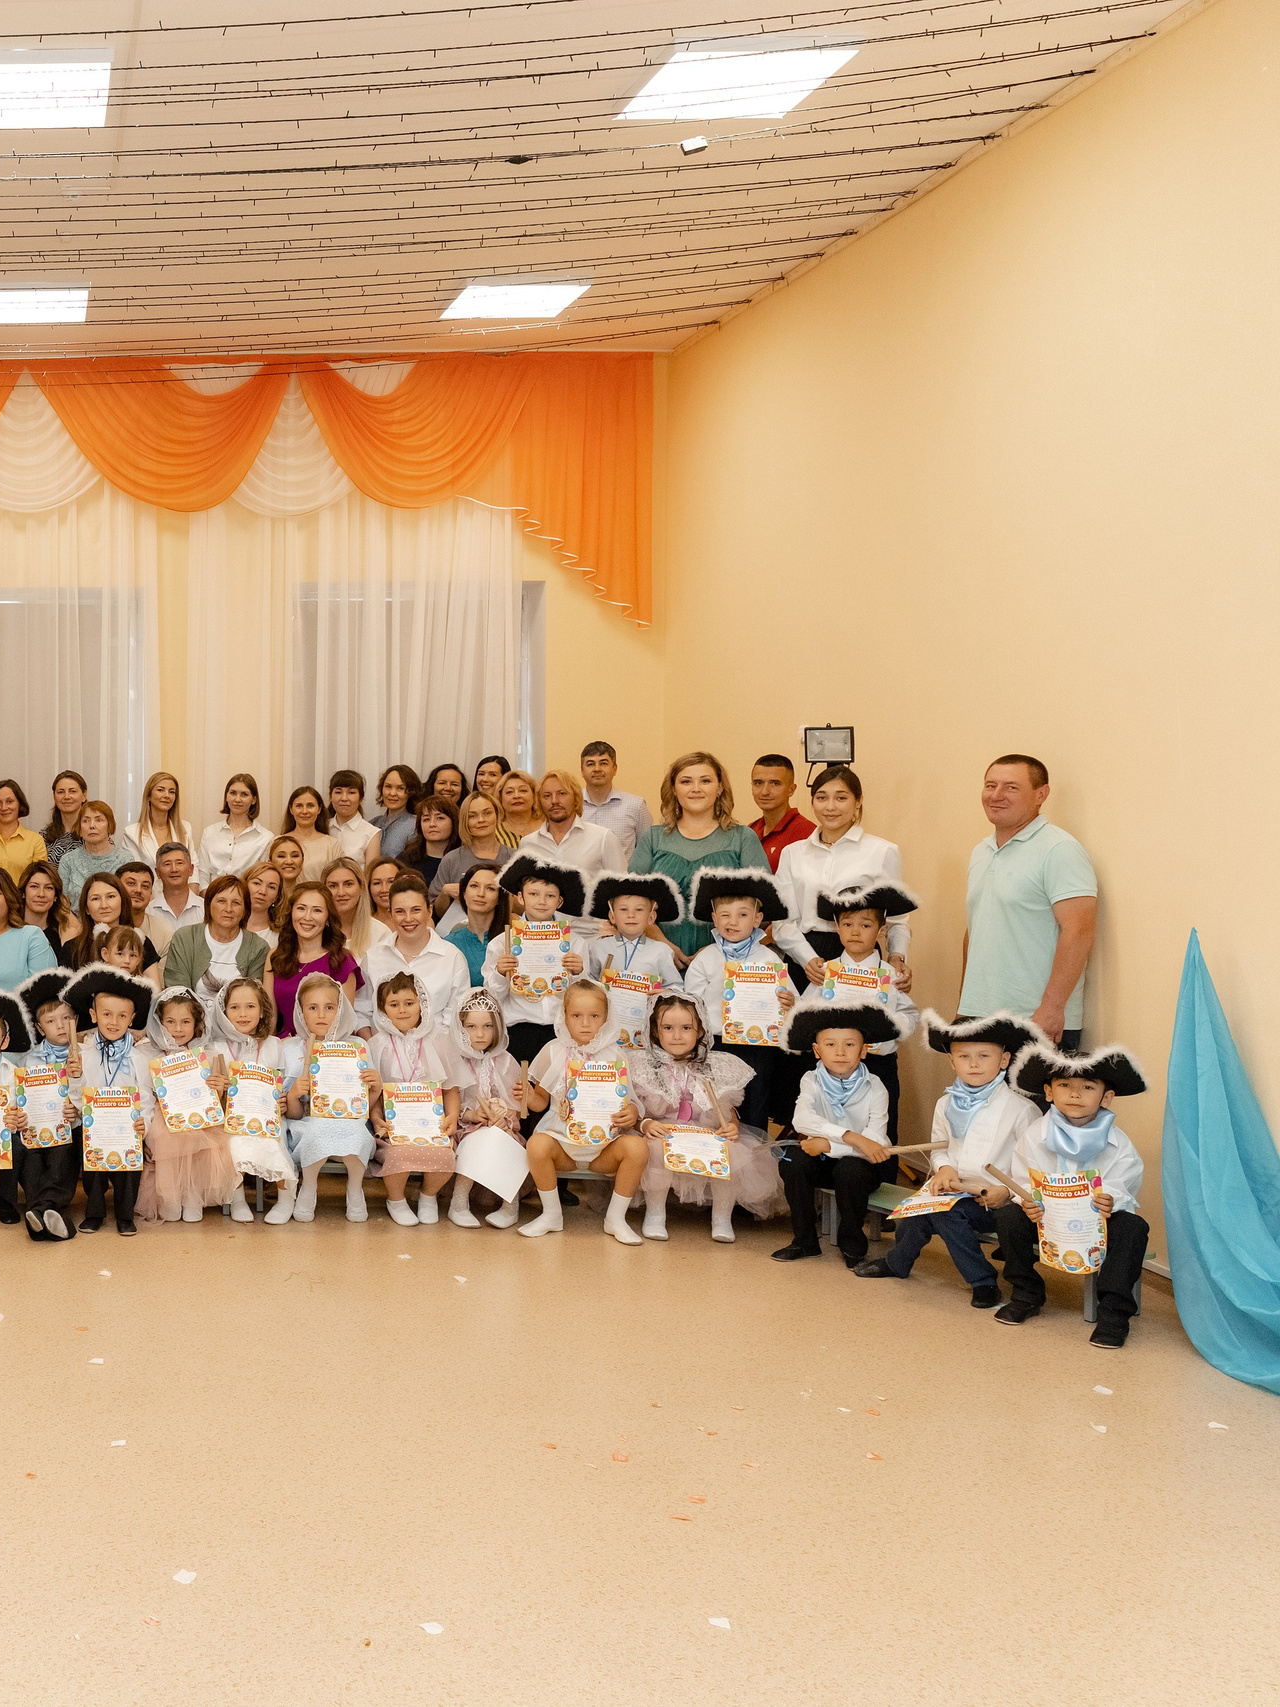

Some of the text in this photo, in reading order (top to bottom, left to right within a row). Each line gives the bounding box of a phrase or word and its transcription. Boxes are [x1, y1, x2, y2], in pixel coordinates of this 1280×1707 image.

[615, 972, 648, 982] ДИПЛОМ
[840, 967, 876, 977] ДИПЛОМ
[161, 1054, 193, 1067] ДИПЛОМ
[25, 1067, 55, 1076] ДИПЛОМ
[241, 1064, 272, 1076] ДИПЛОМ
[1043, 1175, 1085, 1184] ДИПЛОМ
